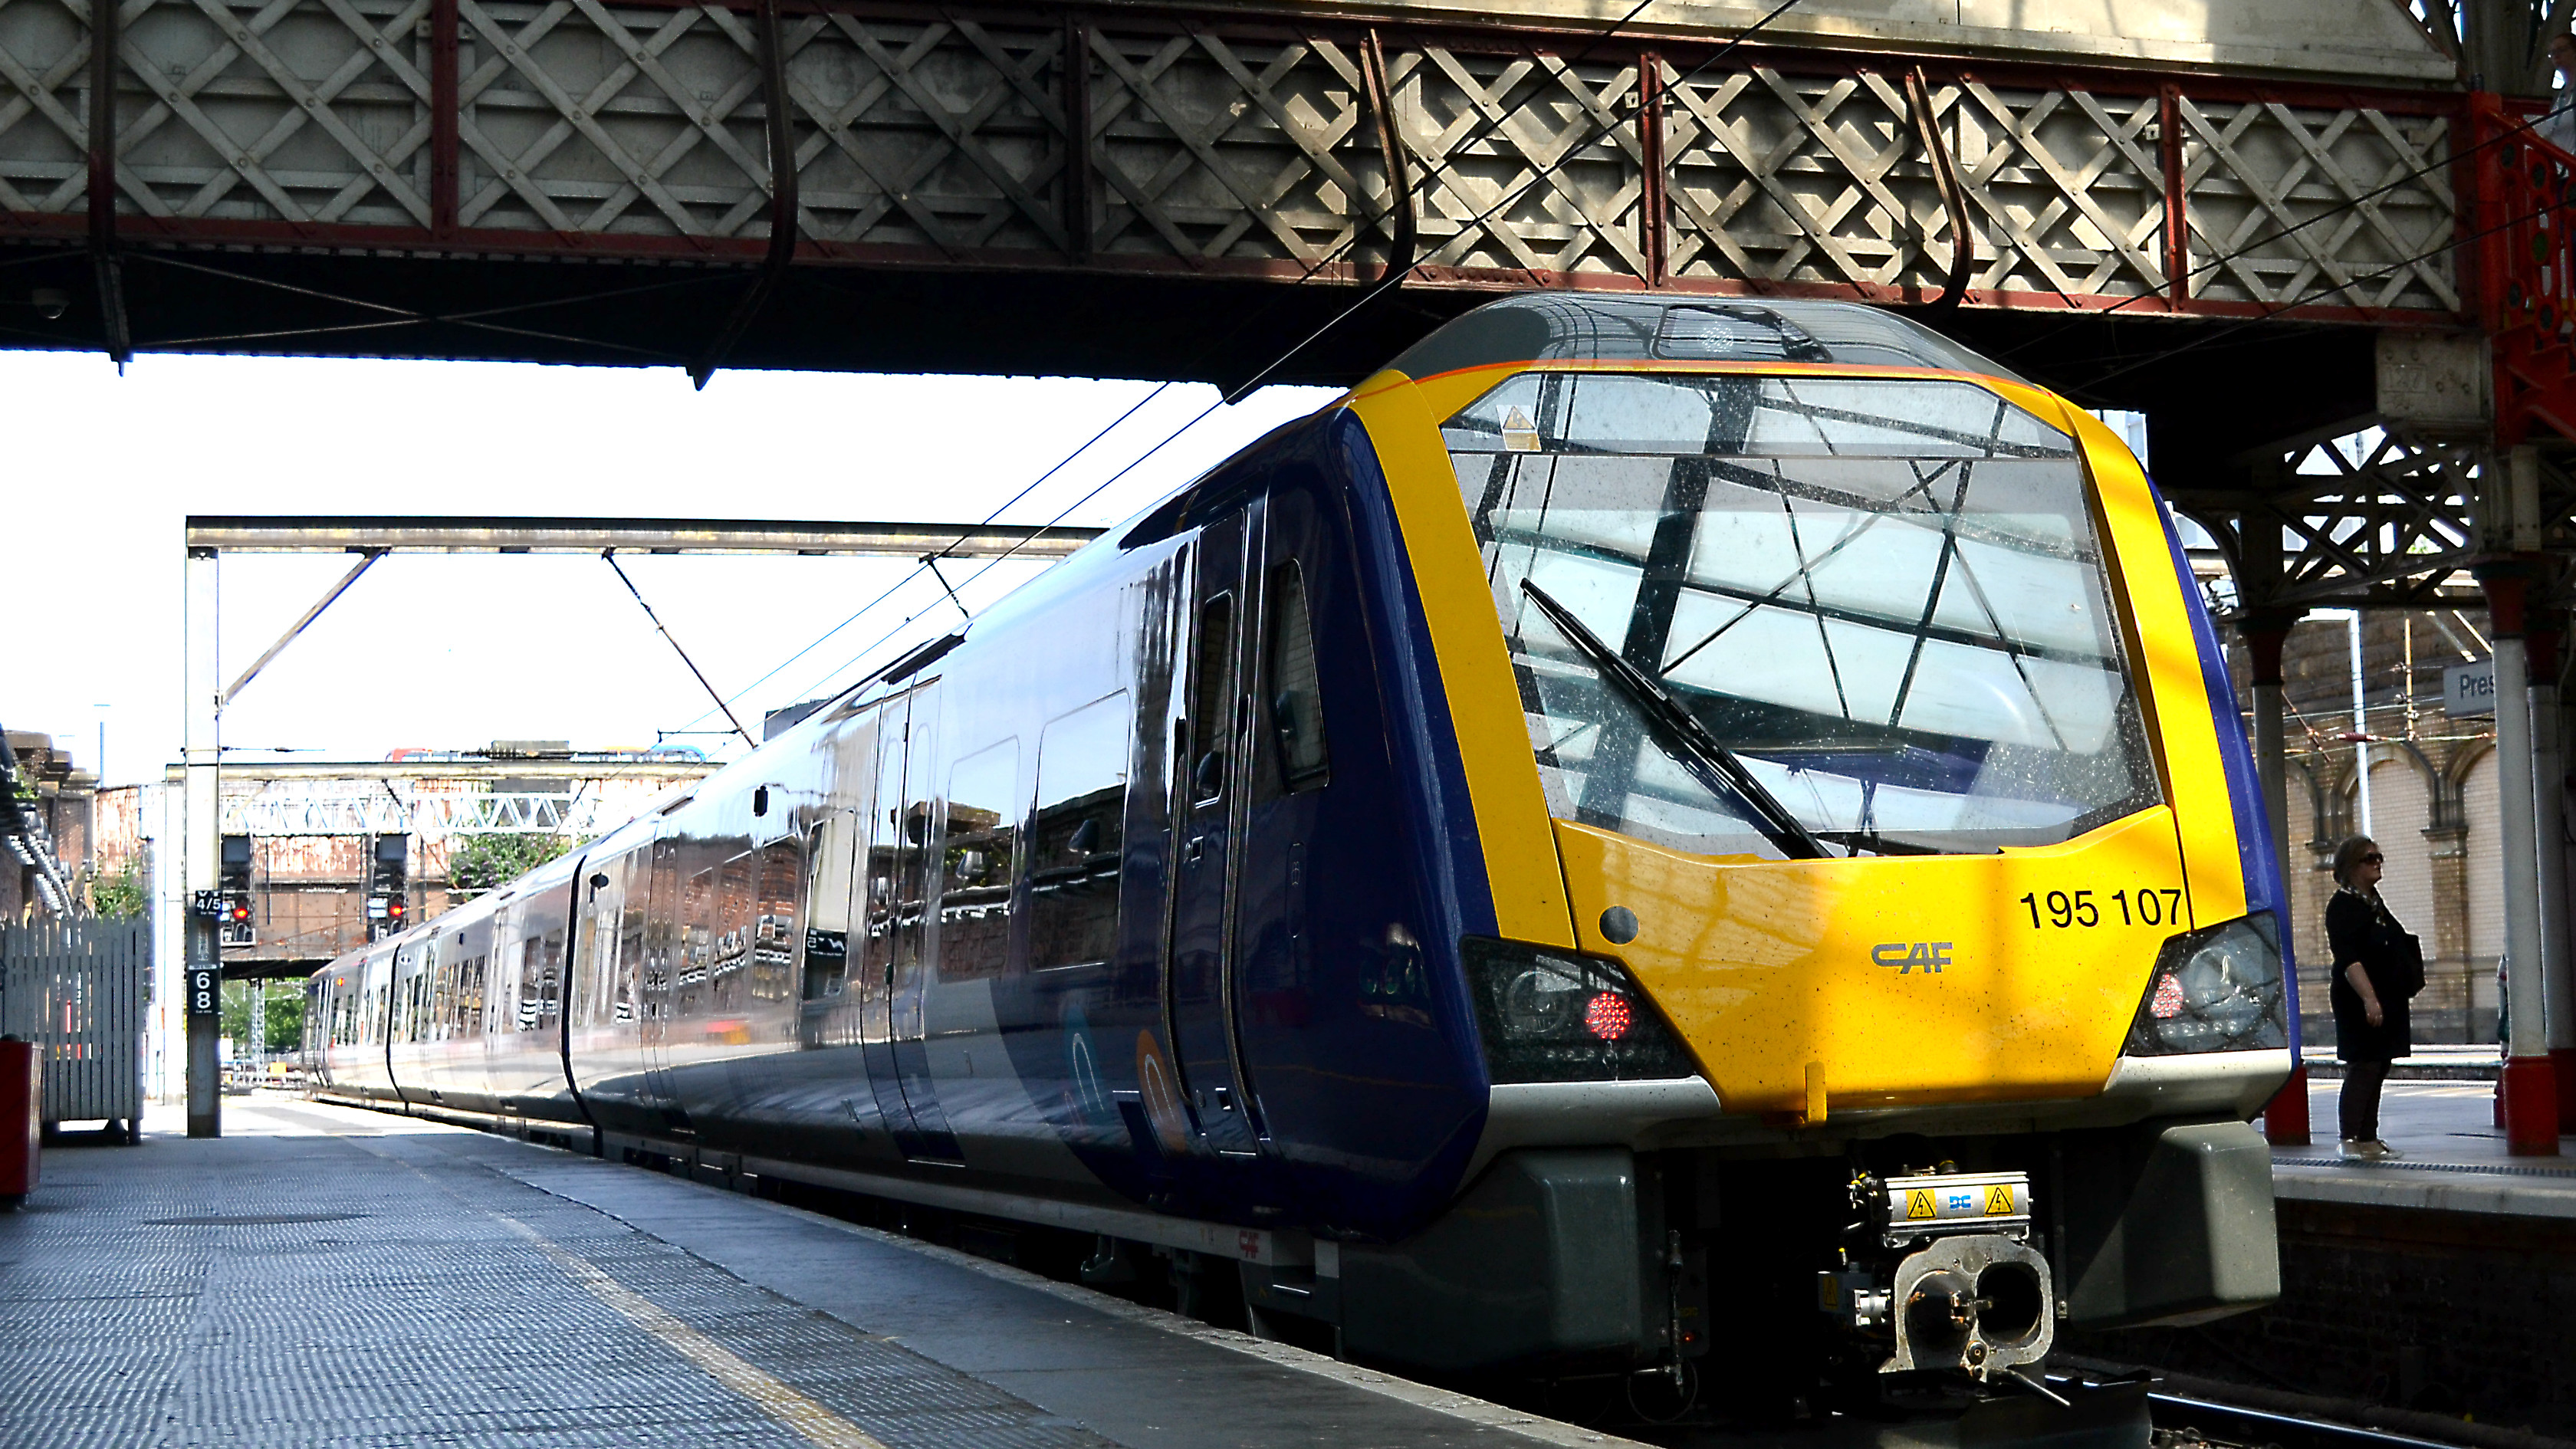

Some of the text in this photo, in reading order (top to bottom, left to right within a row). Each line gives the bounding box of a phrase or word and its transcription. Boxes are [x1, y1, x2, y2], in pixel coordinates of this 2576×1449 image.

[196, 898, 221, 910] 4/5
[2020, 889, 2181, 929] 195 107
[1871, 941, 1953, 974] CAF
[196, 972, 210, 989] 6
[197, 991, 211, 1009] 8
[1239, 1230, 1259, 1259] CAF
